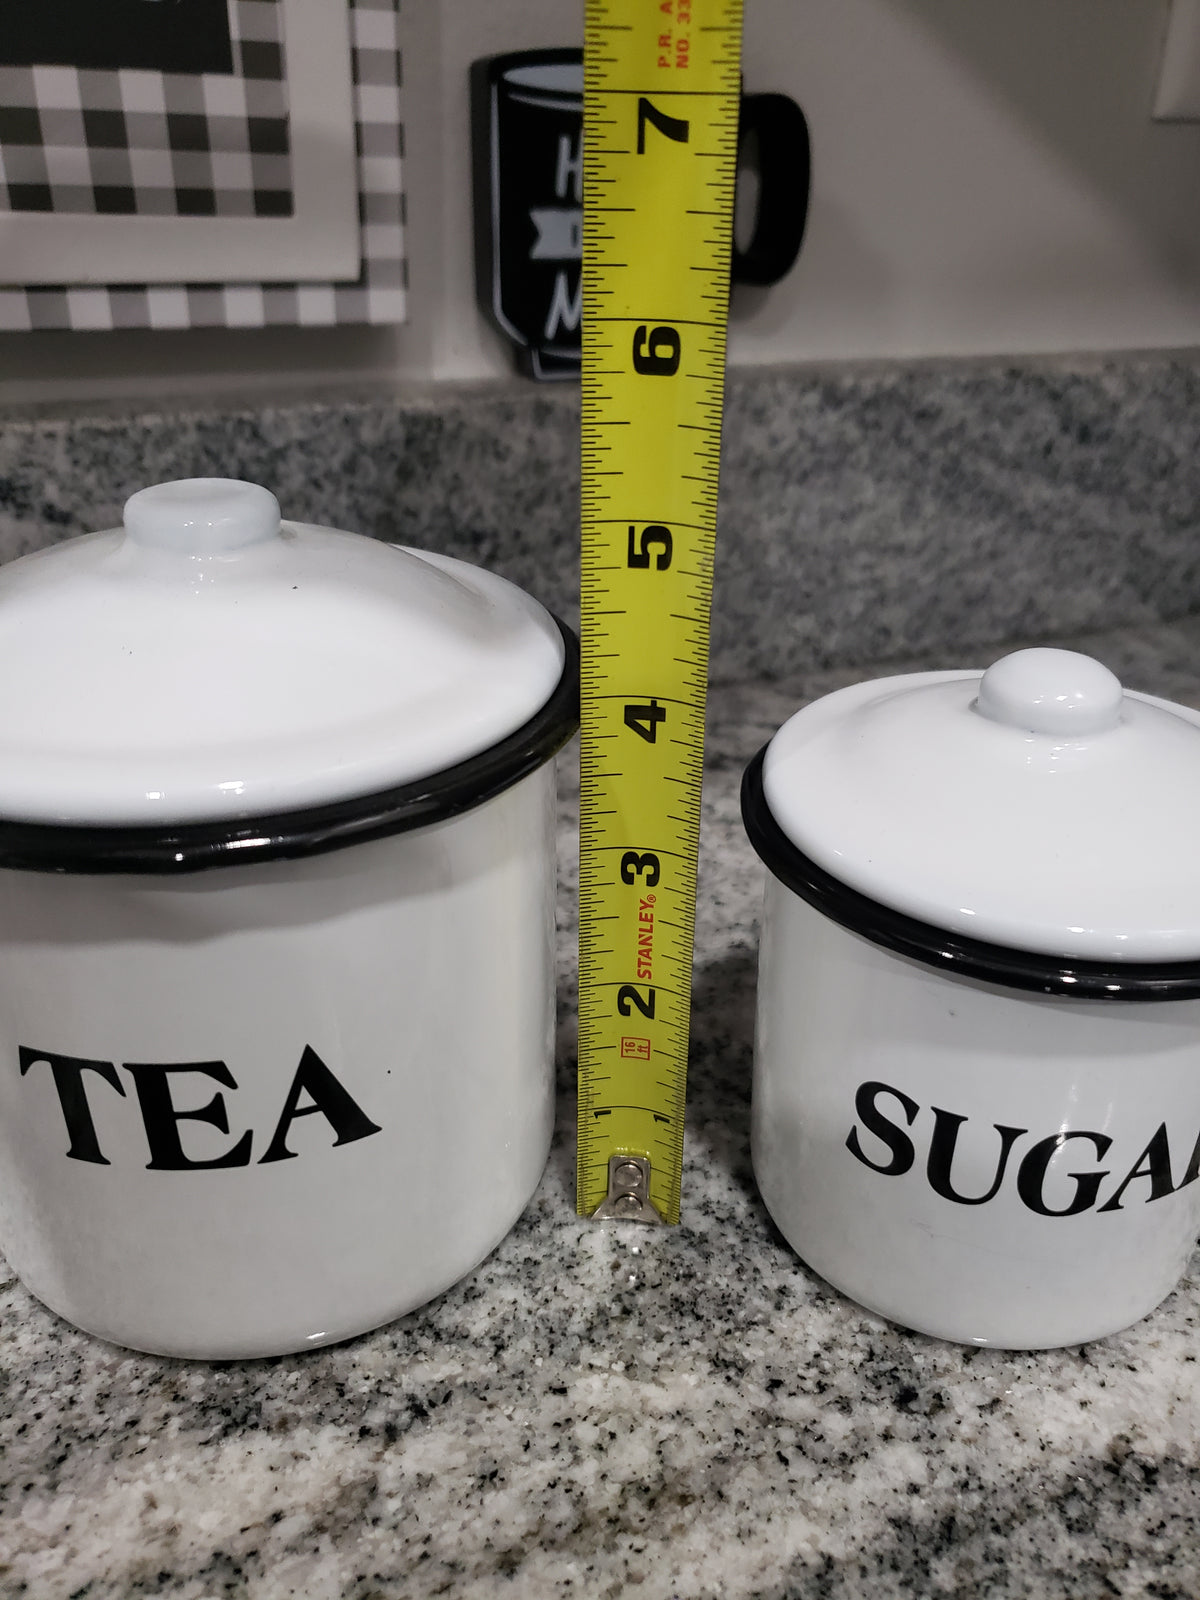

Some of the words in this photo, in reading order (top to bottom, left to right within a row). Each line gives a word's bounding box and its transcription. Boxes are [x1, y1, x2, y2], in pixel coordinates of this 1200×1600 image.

[637, 97, 689, 155] 7
[632, 325, 681, 376] 6
[627, 525, 673, 571] 5
[624, 700, 666, 743] 4
[620, 851, 660, 887] 3
[617, 985, 655, 1020] 2
[624, 1041, 636, 1053] 16
[18, 1043, 383, 1170] TEA
[593, 1110, 611, 1119] 1
[653, 1114, 670, 1124] 1
